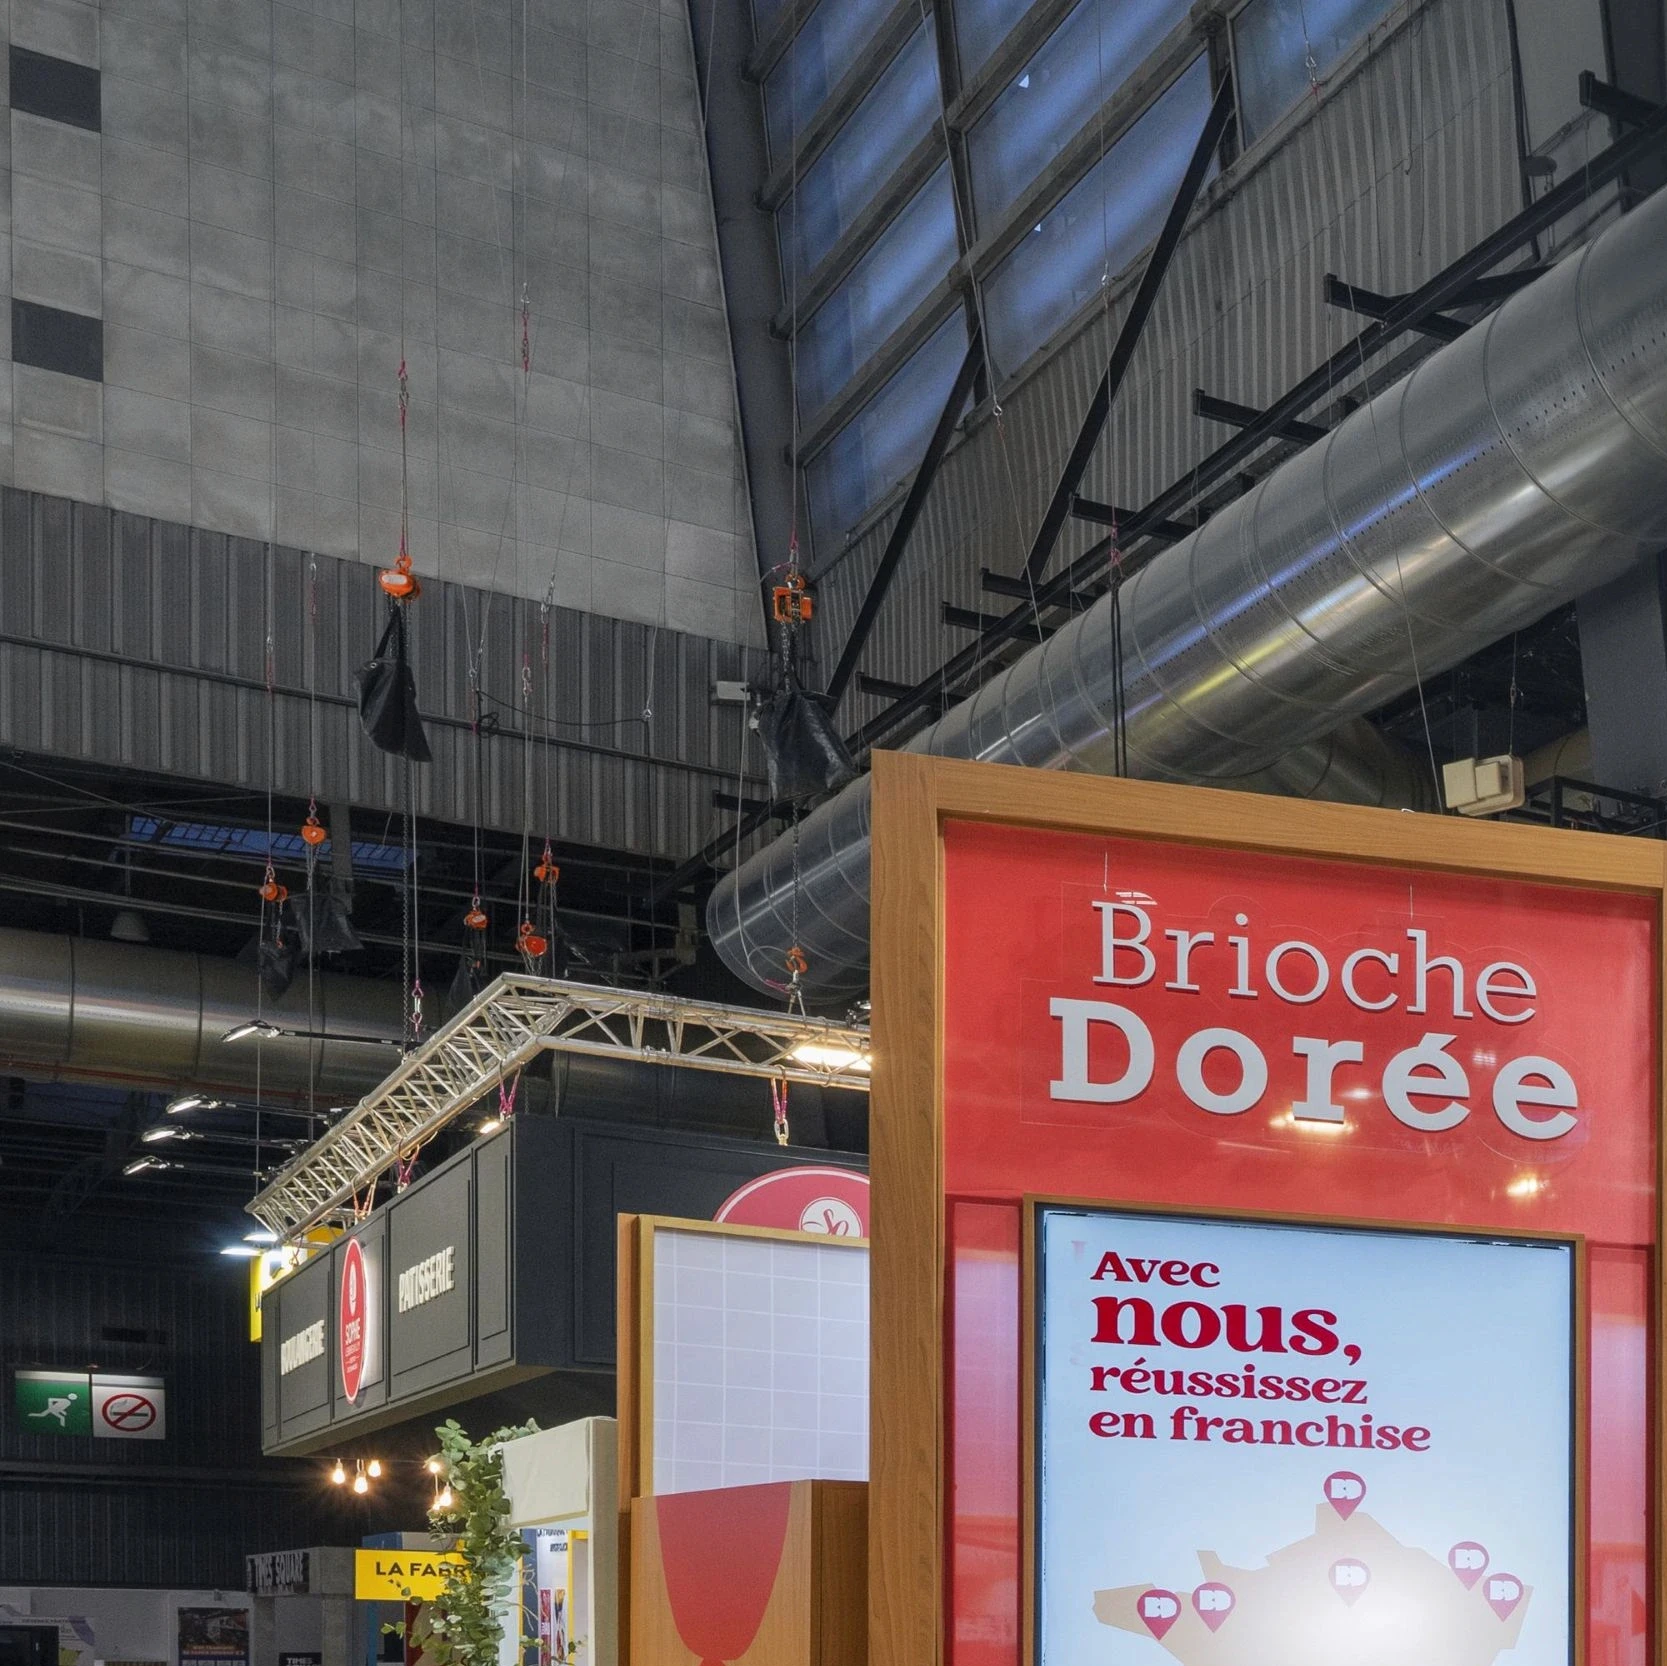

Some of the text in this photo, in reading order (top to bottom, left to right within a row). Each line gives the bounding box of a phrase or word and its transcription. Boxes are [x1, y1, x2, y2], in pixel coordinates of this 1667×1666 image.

[1091, 900, 1537, 1024] Brioche
[1049, 996, 1579, 1140] Dorée
[1090, 1250, 1221, 1288] Avec
[1090, 1295, 1362, 1367] nous,
[1090, 1356, 1368, 1405] réussissez
[1088, 1405, 1432, 1452] en franchise
[376, 1562, 404, 1576] LA
